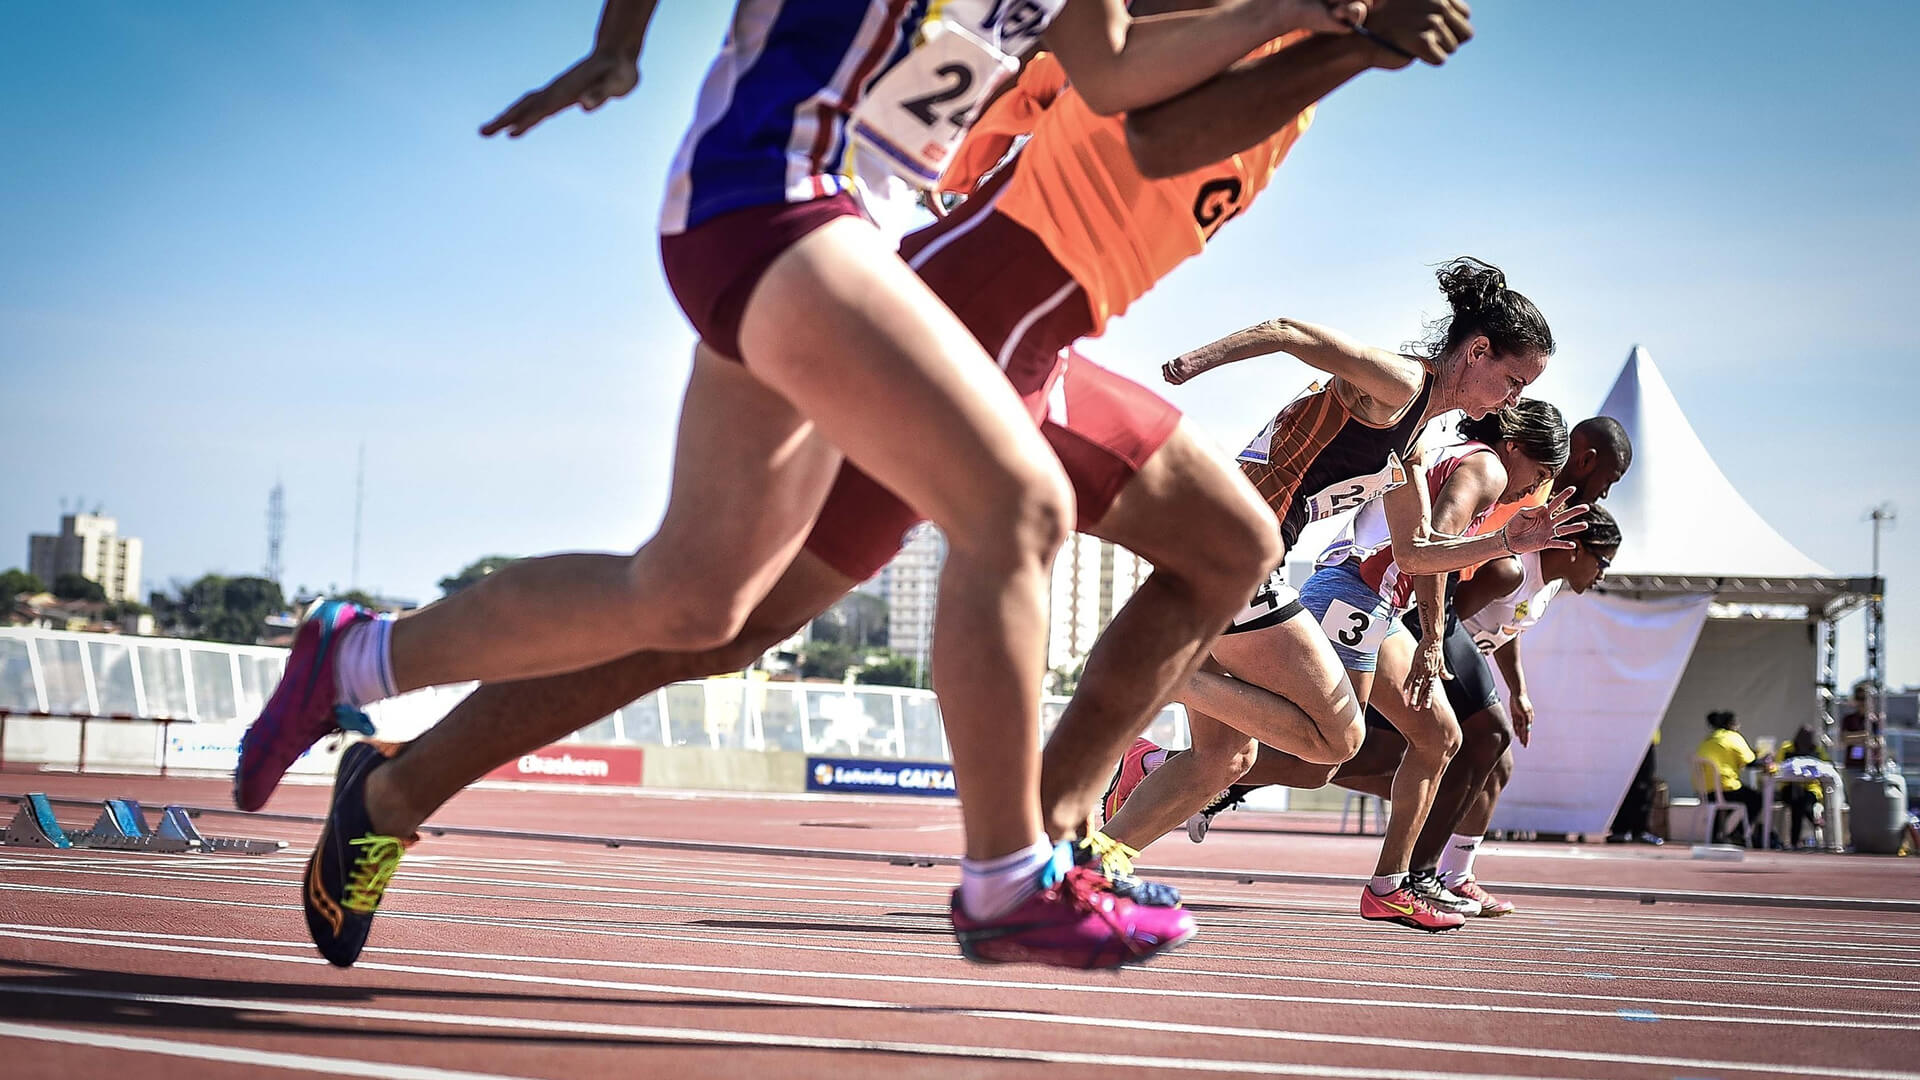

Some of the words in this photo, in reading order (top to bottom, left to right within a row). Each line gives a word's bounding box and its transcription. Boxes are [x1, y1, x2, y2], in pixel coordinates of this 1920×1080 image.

[1193, 177, 1241, 243] G
[1338, 612, 1369, 646] 3
[517, 754, 609, 777] Braskem
[835, 766, 896, 786] Loterias
[897, 768, 956, 790] CAIXA
